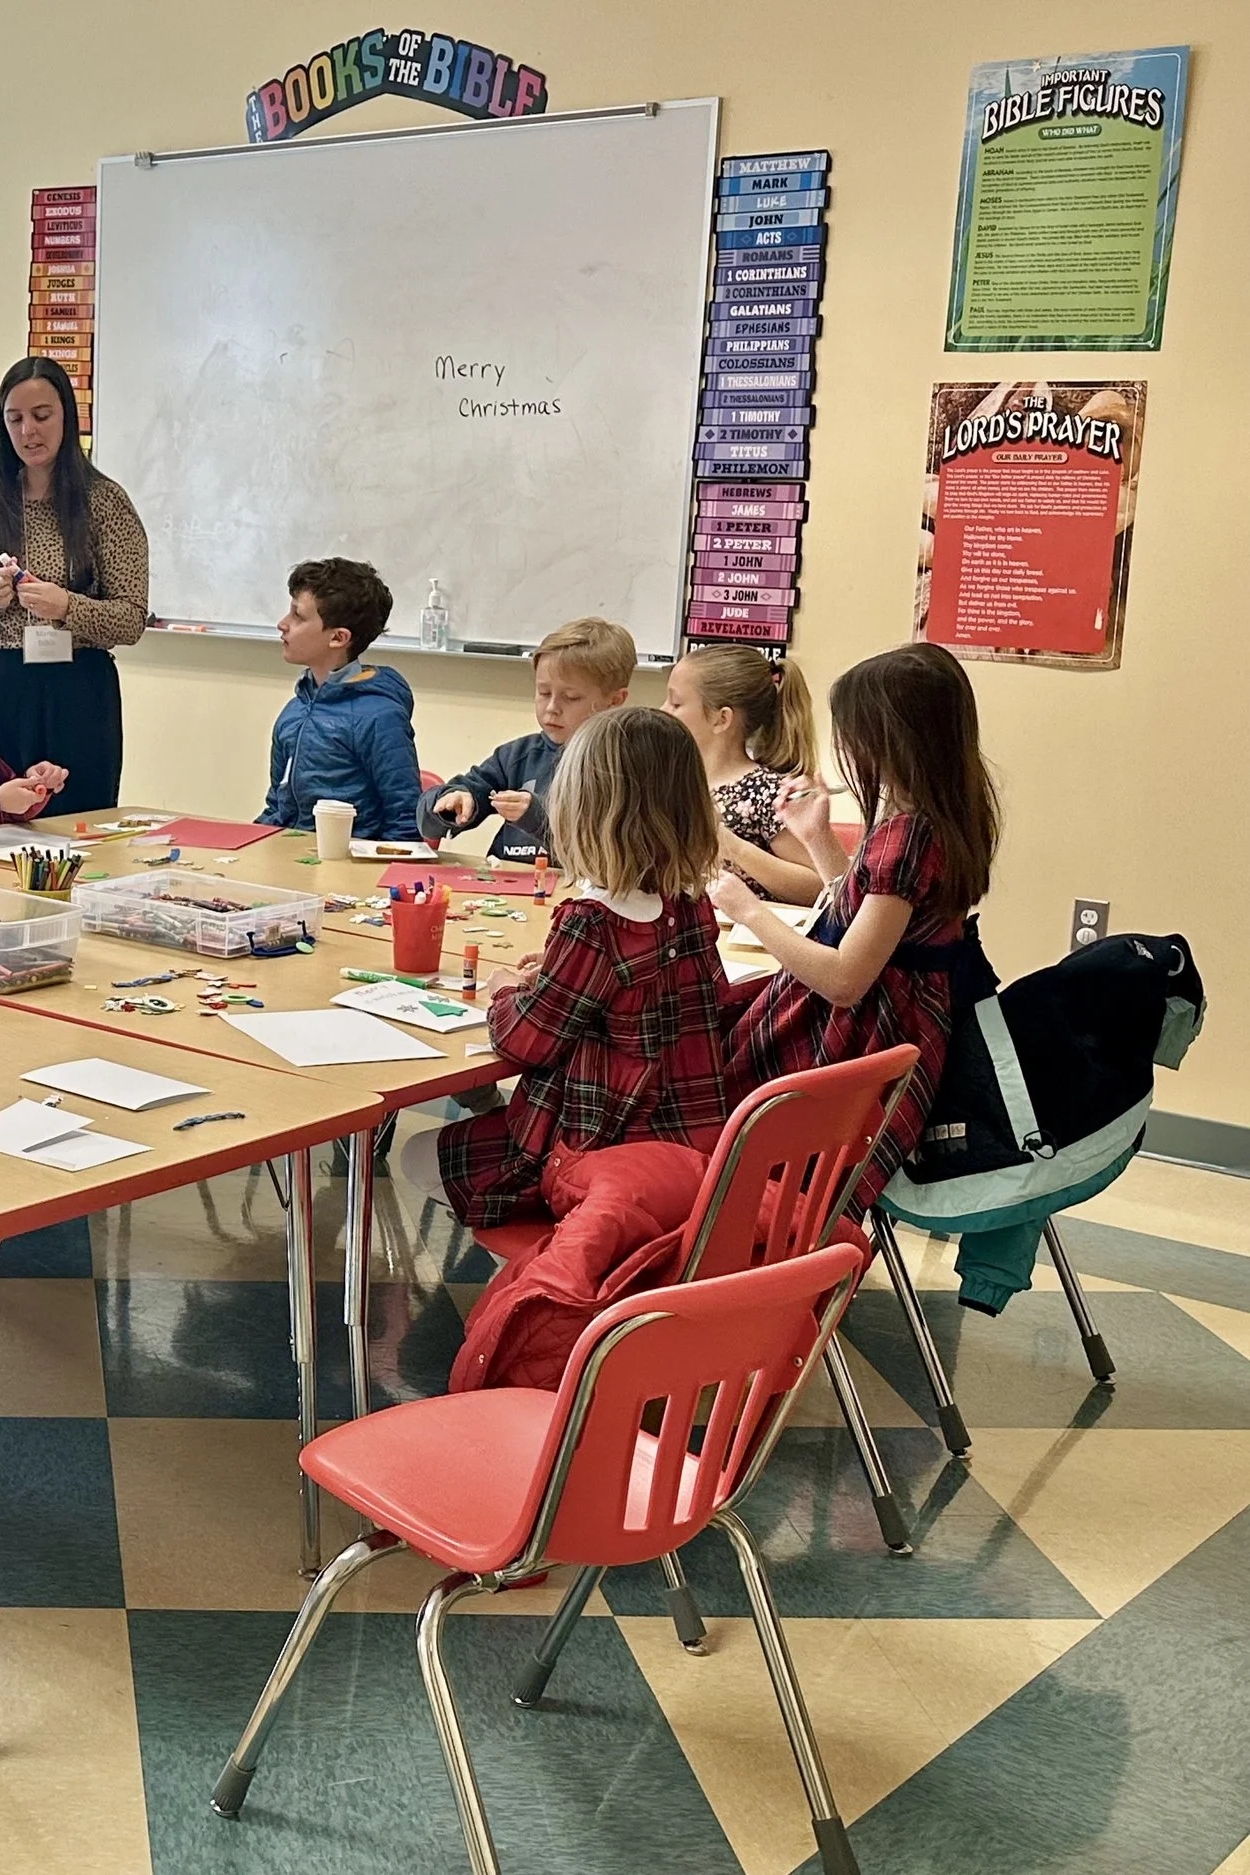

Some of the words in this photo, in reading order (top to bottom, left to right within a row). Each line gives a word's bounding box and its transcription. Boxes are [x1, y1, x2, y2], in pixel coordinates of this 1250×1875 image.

[398, 32, 422, 56] OF
[388, 57, 421, 86] THE
[422, 36, 541, 117] BIBLE
[1041, 70, 1109, 86] IMPORTANT
[258, 31, 385, 139] BOOKS
[982, 90, 1053, 140] BIBLE
[1058, 83, 1162, 125] FIGURES
[1042, 128, 1060, 136] WHO
[1076, 125, 1098, 135] WHAT
[739, 157, 811, 173] MATTHEW
[752, 177, 788, 190] MARK
[47, 193, 81, 201] GENESIS
[756, 196, 787, 208] LUKE
[45, 206, 81, 216] EXODUS
[47, 221, 83, 231] LEVITICUS
[749, 214, 783, 228] JOHN
[45, 236, 81, 245] NUMBERS
[756, 232, 782, 245] ACTS
[742, 250, 794, 262] ROMANS
[727, 271, 732, 281] 1
[736, 266, 807, 281] CORINTHIANS
[47, 279, 75, 288] JUDGES
[725, 289, 731, 298] 2
[732, 285, 806, 298] CORINTHIANS
[51, 308, 76, 316] SAMUEL
[730, 304, 792, 316] GALATIANS
[736, 322, 790, 334] EPHESIANS
[51, 336, 75, 344] KINGS
[726, 340, 790, 352] PHILIPPIANS
[719, 357, 795, 369] COLOSSIANS
[435, 355, 506, 387] Merry
[720, 377, 724, 388] 1
[727, 375, 796, 388] THESSALONIANS
[723, 395, 727, 403] 2
[729, 394, 784, 403] THESSALONIANS
[1023, 397, 1045, 409] THE
[458, 398, 561, 417] Christmas
[731, 412, 736, 422] 1
[740, 411, 781, 422] TIMOTHY
[720, 429, 726, 439] 2
[730, 429, 783, 439] TIMOTHY
[942, 410, 1023, 459] LORD'S
[1027, 411, 1121, 459] PRAYER
[730, 446, 768, 458] TITUS
[712, 463, 790, 474] PHILEMON
[723, 487, 772, 498] HEBREWS
[731, 505, 766, 516] JAMES
[717, 523, 721, 531] 1
[726, 522, 772, 533] PETER
[713, 539, 721, 548] 2
[724, 539, 772, 550] PETER
[724, 556, 728, 566] 1
[732, 556, 763, 568] JOHN
[718, 572, 724, 582] 2
[728, 573, 759, 585] JOHN
[724, 590, 729, 600] 3
[732, 590, 758, 602] JOHN
[721, 607, 749, 619] JUDE
[701, 622, 771, 636] REVELATION
[504, 846, 536, 855] NDER
